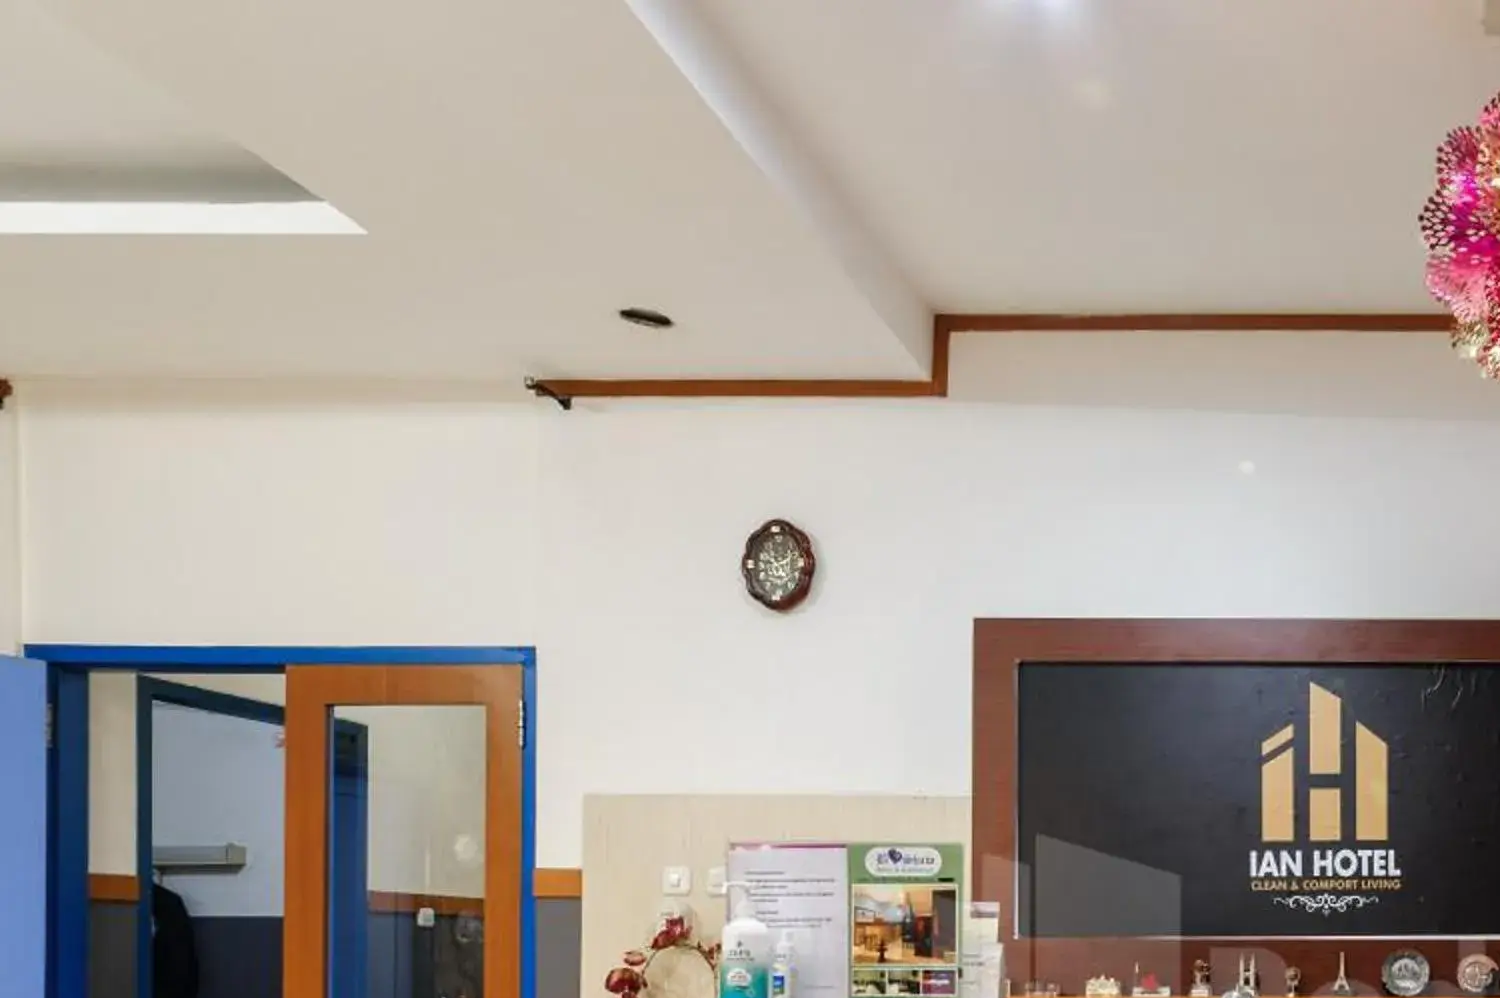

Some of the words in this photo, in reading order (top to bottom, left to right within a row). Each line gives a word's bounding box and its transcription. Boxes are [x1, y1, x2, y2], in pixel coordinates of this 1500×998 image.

[1250, 850, 1303, 876] IAN
[1313, 850, 1401, 876] HOTEL
[1251, 880, 1288, 891] CLEAN
[1292, 880, 1300, 891] &
[1361, 879, 1401, 891] LIVING
